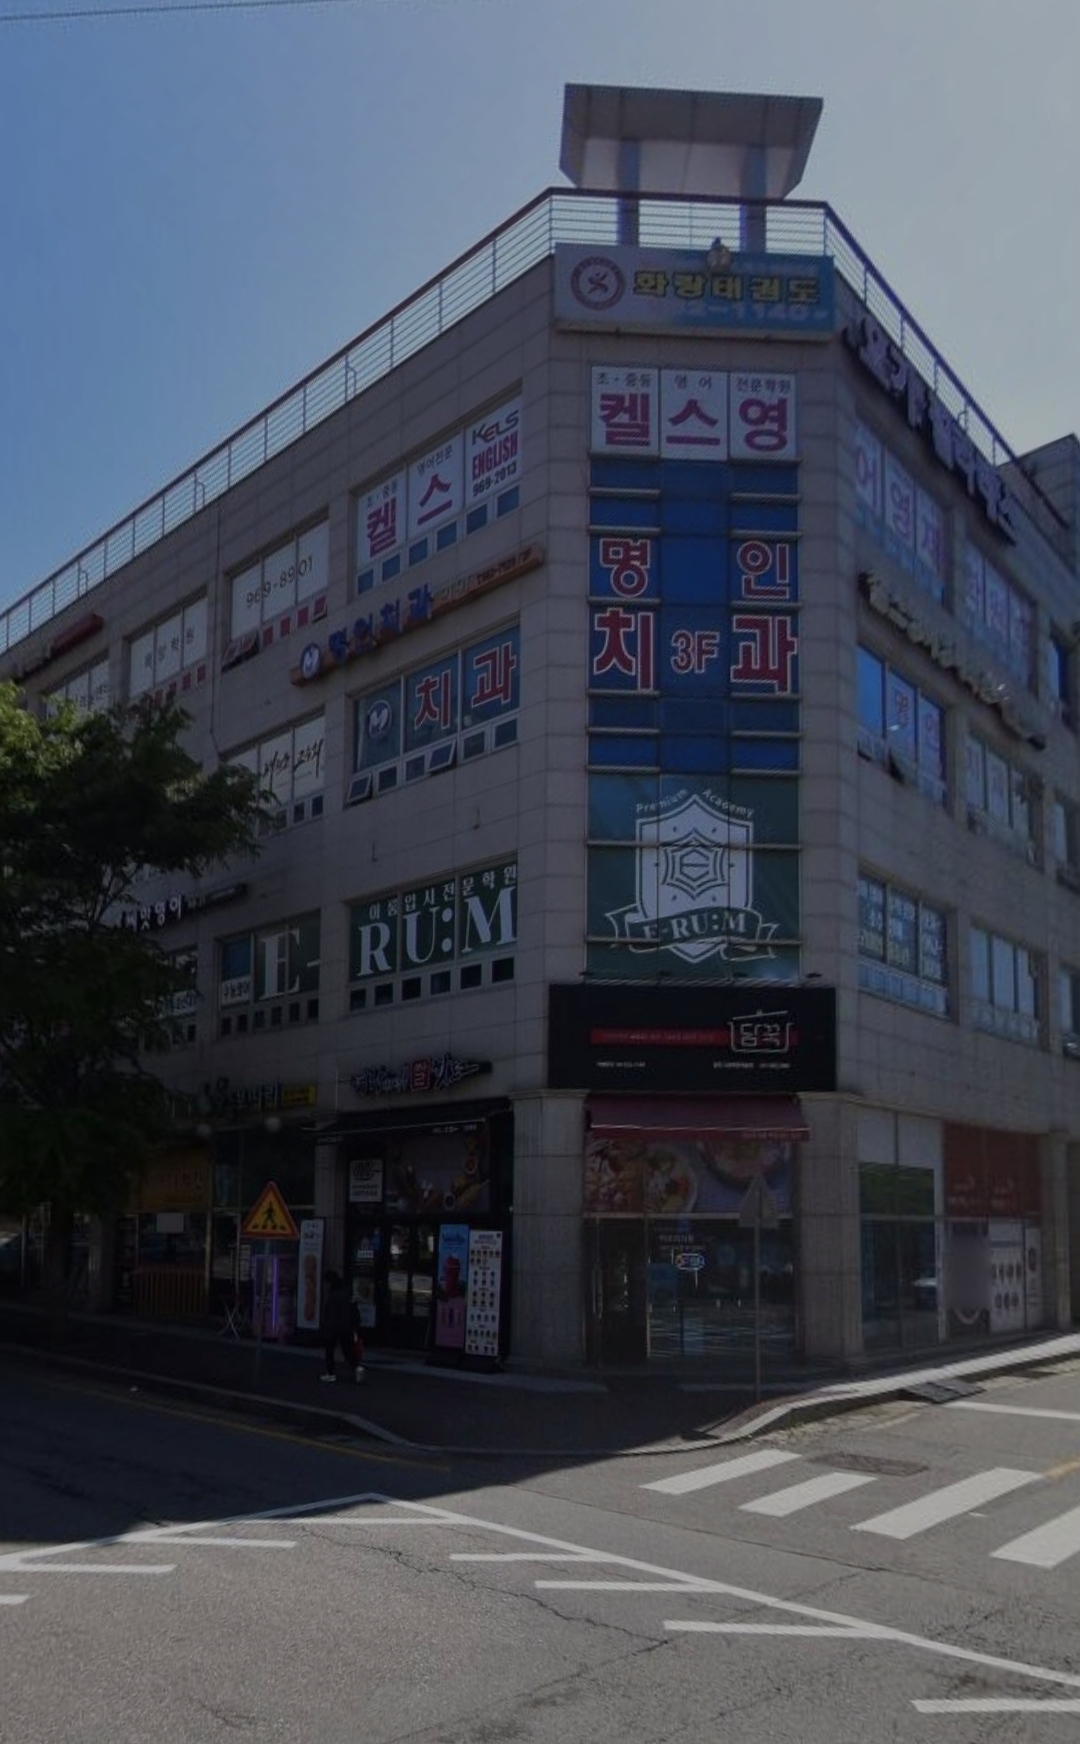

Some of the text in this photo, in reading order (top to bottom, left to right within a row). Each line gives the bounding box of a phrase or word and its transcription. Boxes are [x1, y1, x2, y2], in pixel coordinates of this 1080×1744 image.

[633, 270, 822, 304] 화랑태권도
[472, 409, 520, 446] KELS
[472, 430, 519, 481] ENGLISH
[671, 629, 720, 674] 3F
[414, 641, 517, 730] 치과
[701, 788, 755, 818] Academy
[643, 910, 748, 940] E-RU:M
